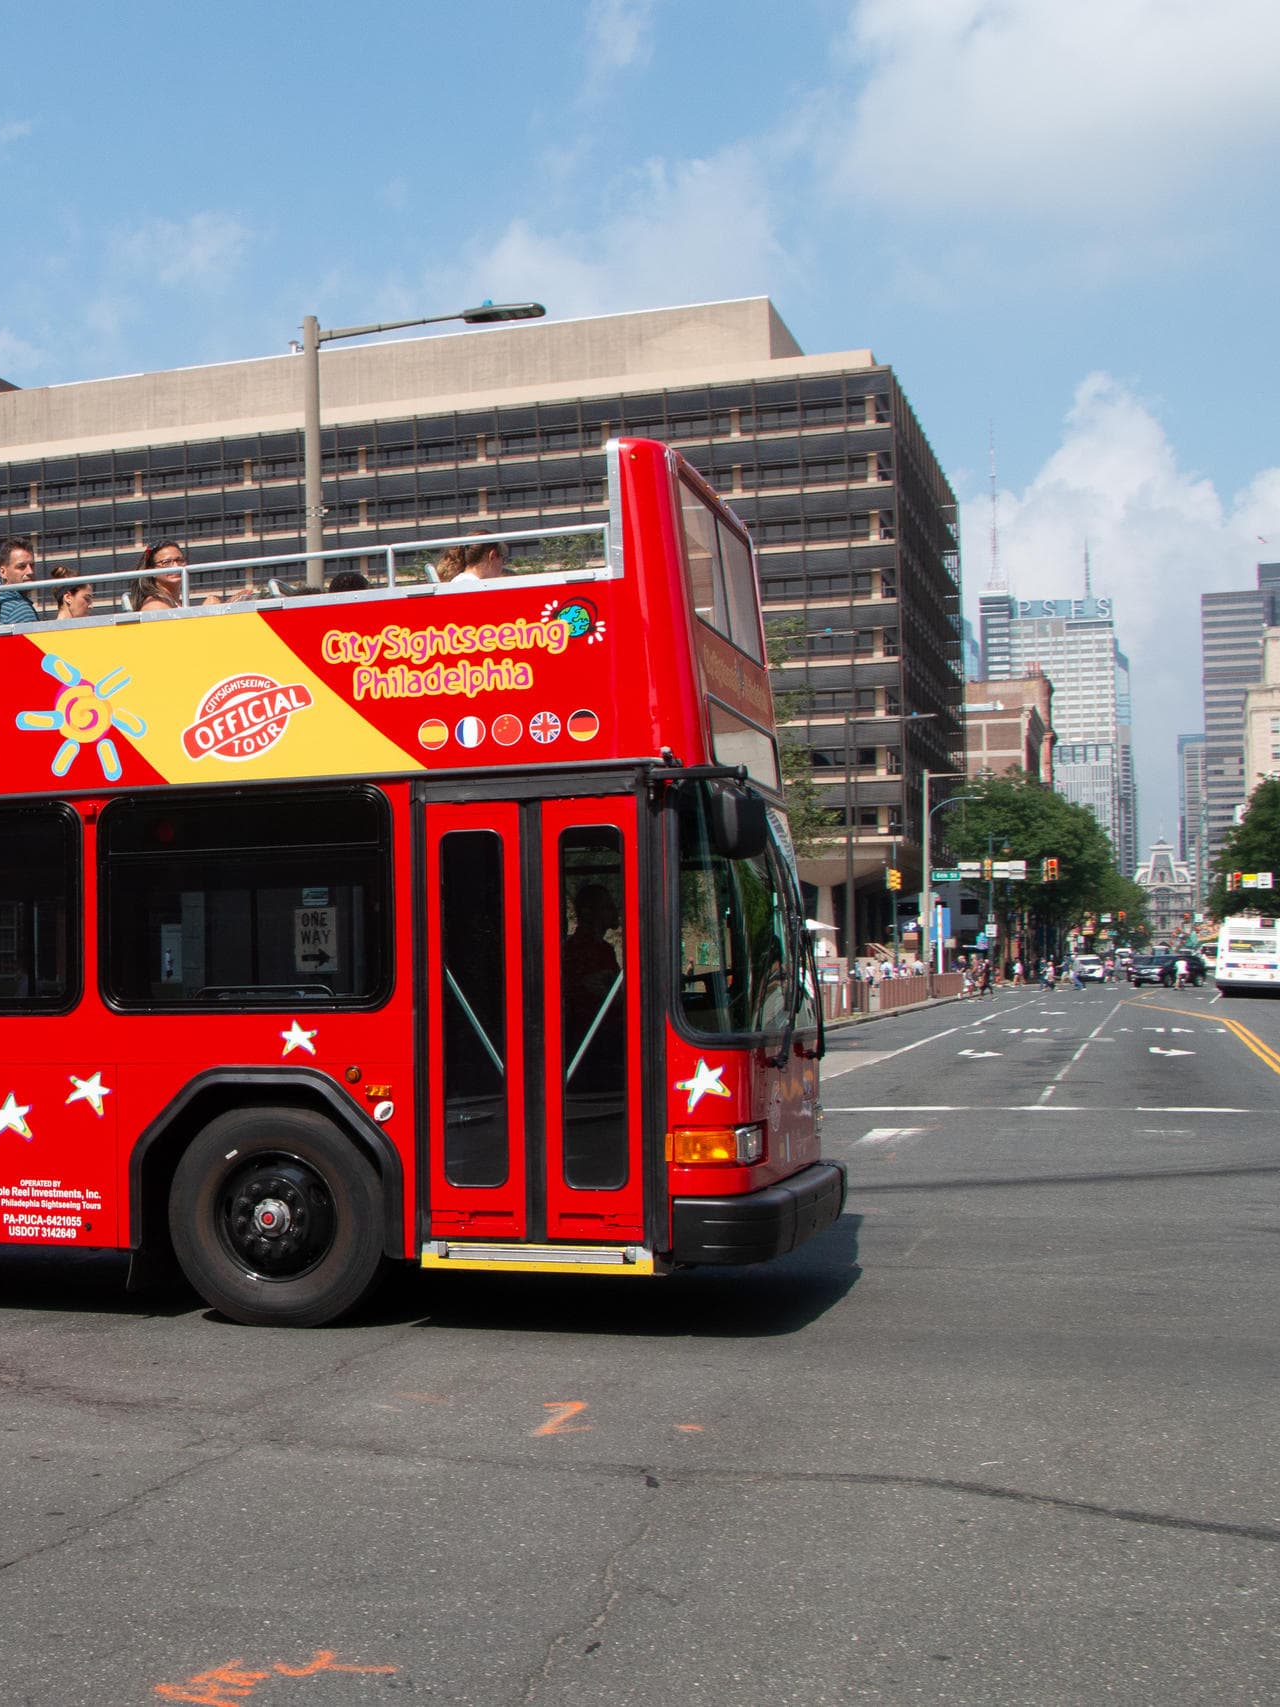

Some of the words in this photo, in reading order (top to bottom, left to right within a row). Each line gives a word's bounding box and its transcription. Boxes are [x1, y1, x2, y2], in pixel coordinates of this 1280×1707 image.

[353, 658, 534, 700] Philadelphia
[205, 679, 272, 713] CITYSIGHTSEEING
[194, 687, 305, 750] OFFICIAL
[231, 722, 282, 754] TOUR
[301, 911, 329, 928] ONE
[301, 929, 331, 945] WAY
[20, 1179, 52, 1187] OPERATED
[53, 1180, 61, 1188] BY
[11, 1186, 30, 1197] Reel
[31, 1187, 84, 1199] Investments,
[85, 1189, 102, 1199] Inc.
[41, 1199, 81, 1211] Sightseeing
[82, 1201, 102, 1210] Tours
[3, 1213, 82, 1227] PA-PUCA-6421055
[8, 1225, 40, 1237] USDOT
[41, 1227, 77, 1239] 3142649
